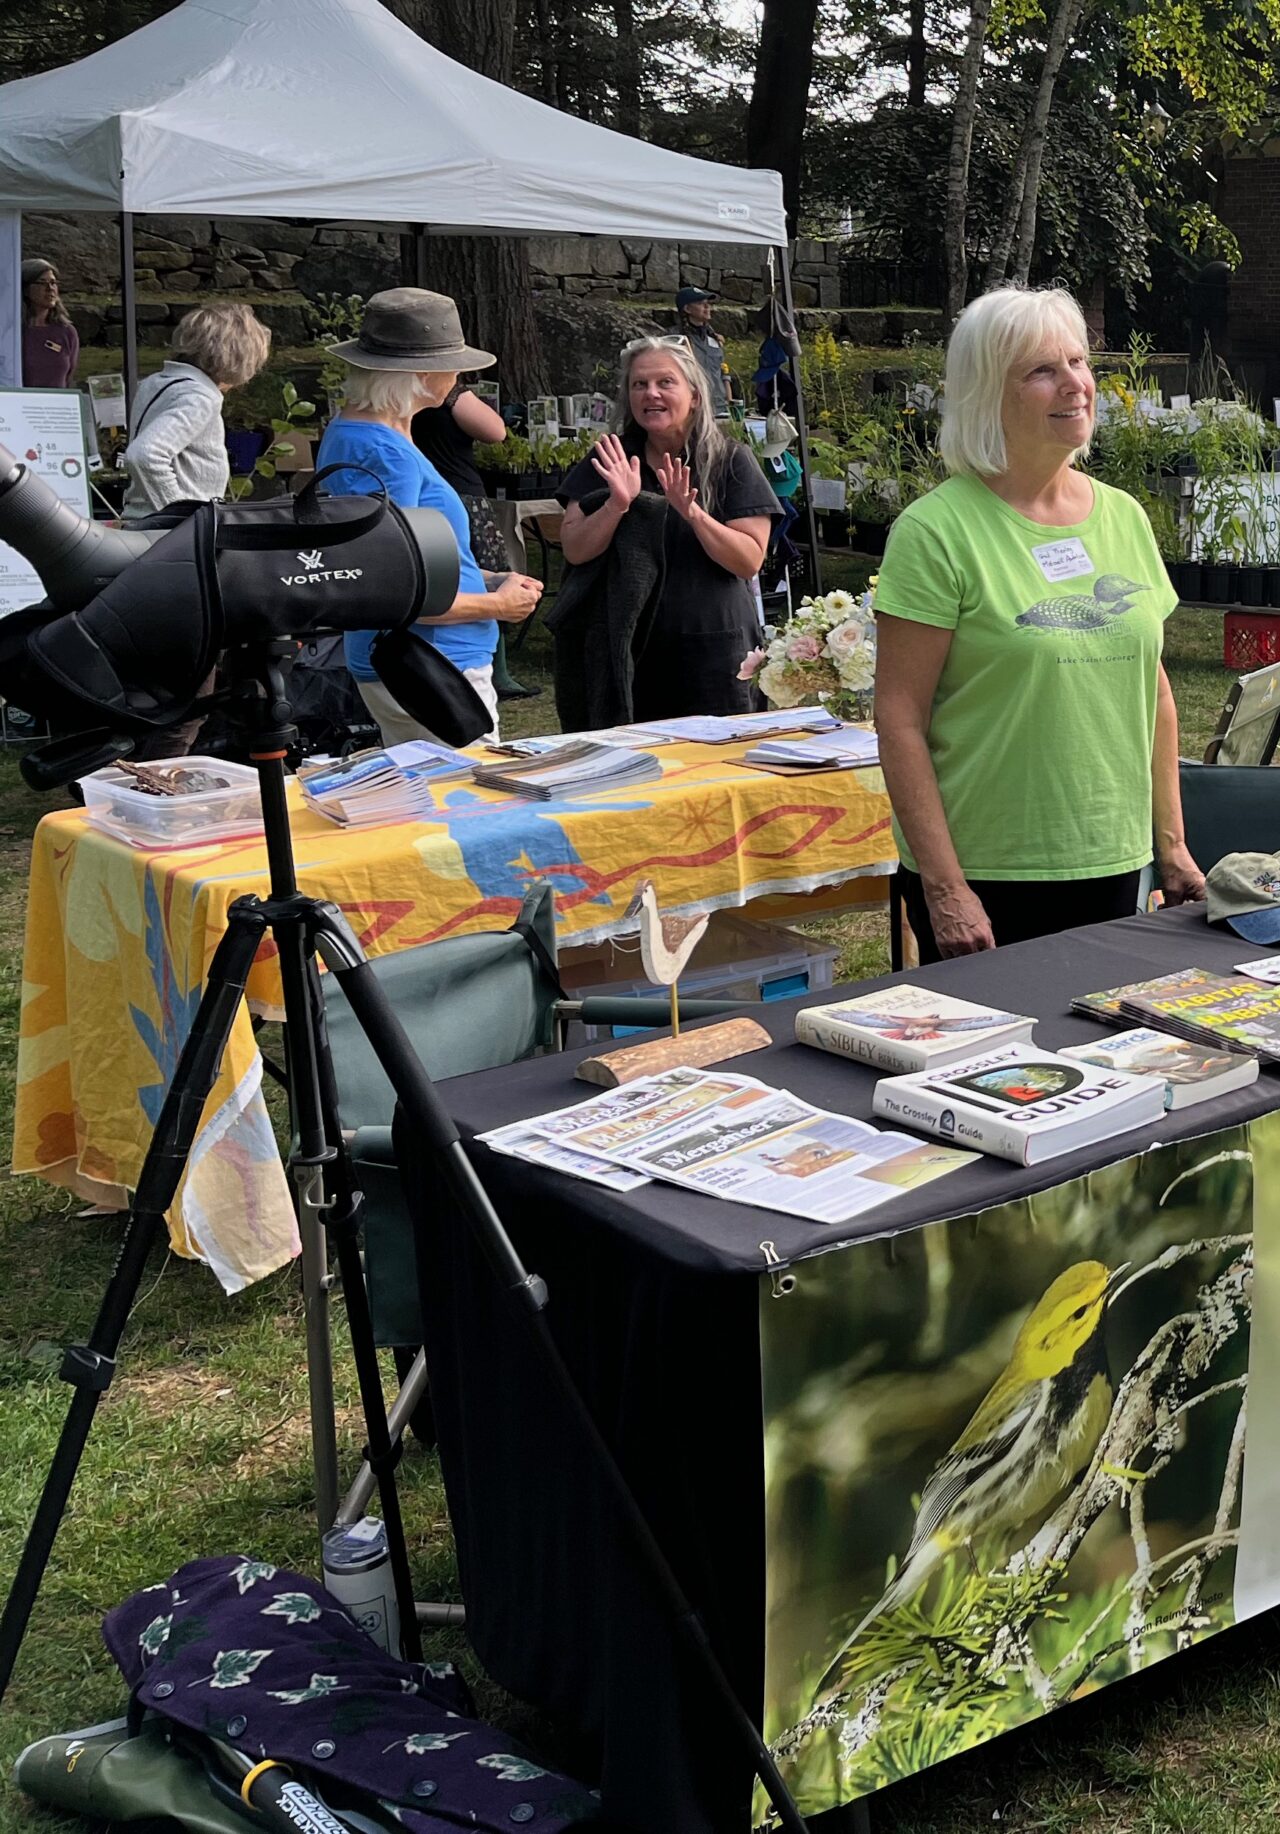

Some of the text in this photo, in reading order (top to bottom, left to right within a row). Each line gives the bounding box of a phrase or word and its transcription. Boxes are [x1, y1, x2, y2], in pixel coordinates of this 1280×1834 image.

[1056, 656, 1077, 664] Lake
[1105, 654, 1136, 662] George
[1152, 982, 1262, 1012] HABITAT
[829, 1030, 876, 1060] SIBLEY
[1096, 1032, 1158, 1051] Birds
[877, 1052, 905, 1070] BIRDS
[926, 1050, 1020, 1082] CROSSLEY
[558, 1086, 667, 1134] Merganser
[1001, 1077, 1131, 1122] GUIDE
[591, 1097, 697, 1147] Merganser
[883, 1098, 984, 1141] The Crossley Guide
[659, 1120, 773, 1167] Merganser
